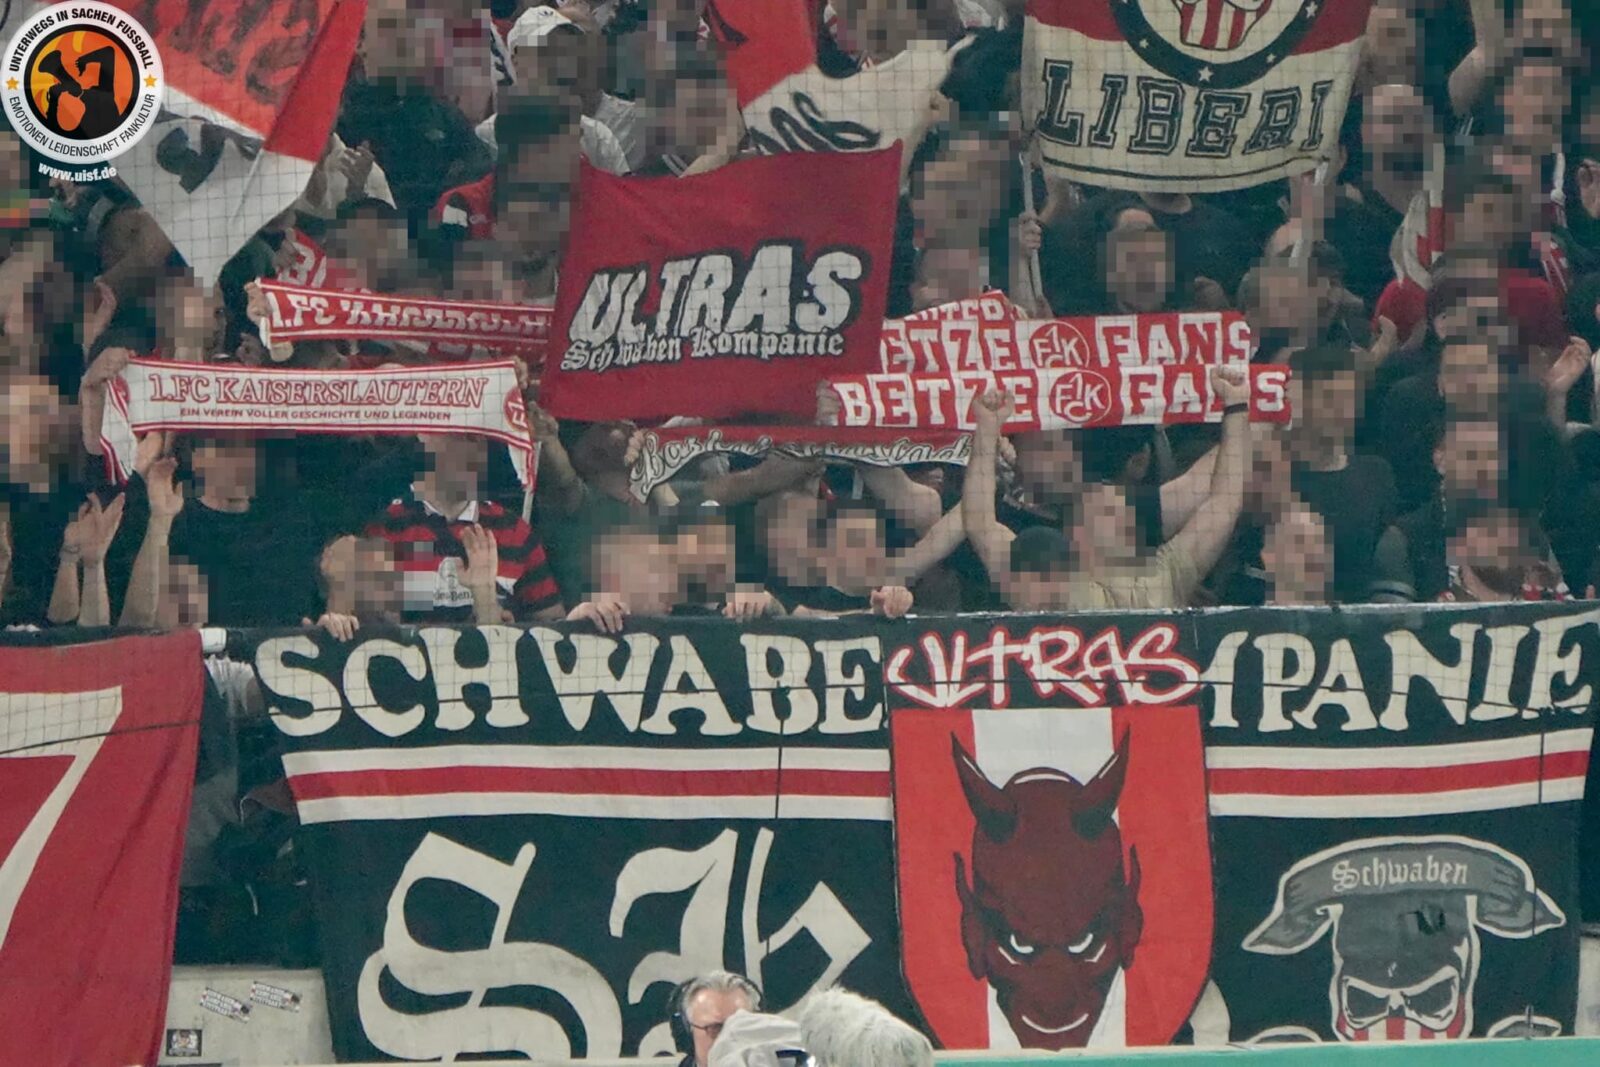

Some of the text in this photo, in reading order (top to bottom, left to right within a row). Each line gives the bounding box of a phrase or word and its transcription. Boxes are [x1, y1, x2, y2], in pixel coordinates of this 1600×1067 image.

[568, 244, 862, 348] ULTRAS
[690, 326, 844, 360] Kompanie
[149, 374, 209, 403] 1.FC
[215, 375, 489, 408] KAISERSLAUTERN
[1127, 370, 1286, 418] FAS
[180, 407, 451, 420] EIN VEREIN VOLLER GESCHICHTE UND LEGENDEN
[255, 625, 888, 737] SCHWABE
[886, 622, 1201, 709] ULTRAS
[1331, 855, 1468, 892] Schwaben
